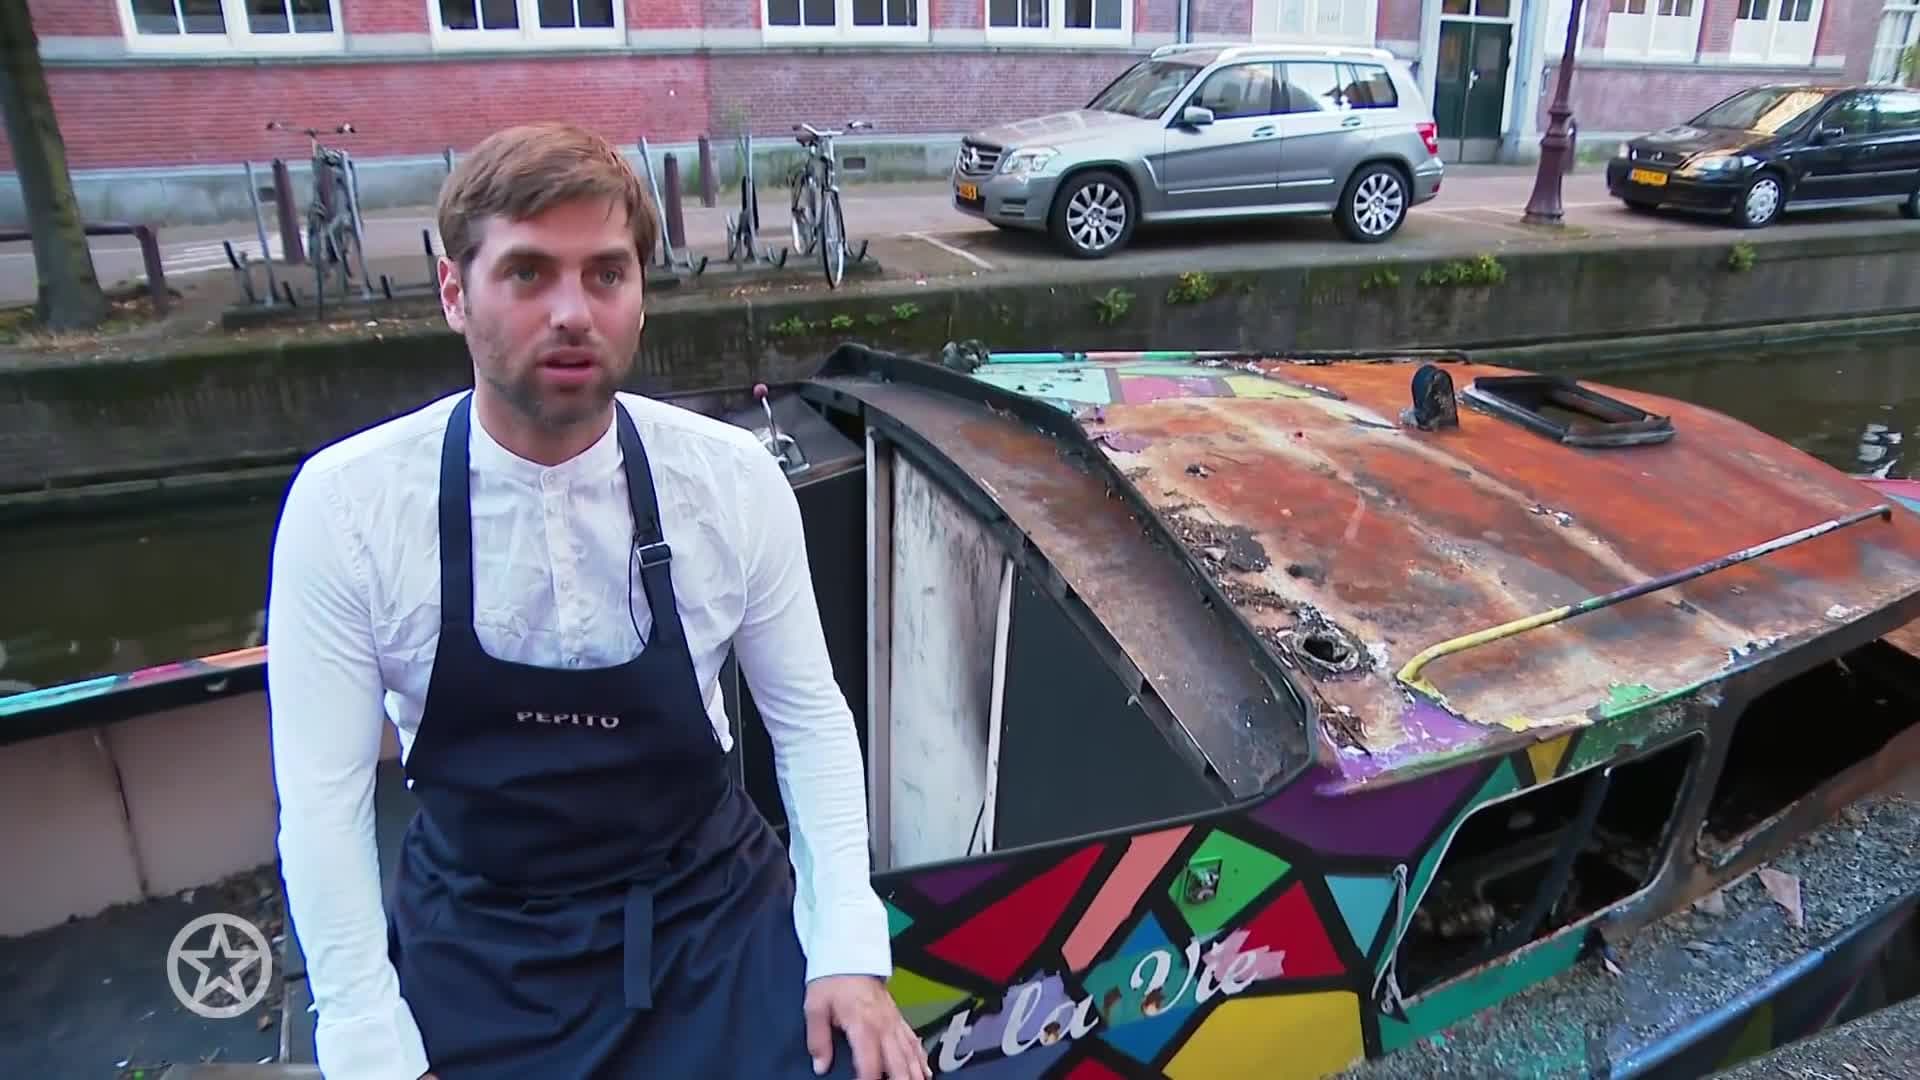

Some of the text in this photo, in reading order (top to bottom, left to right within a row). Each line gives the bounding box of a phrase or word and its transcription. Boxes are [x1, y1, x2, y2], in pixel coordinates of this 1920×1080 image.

[515, 711, 620, 729] PEPITO
[1001, 981, 1099, 1057] la
[1130, 936, 1260, 1016] Vie
